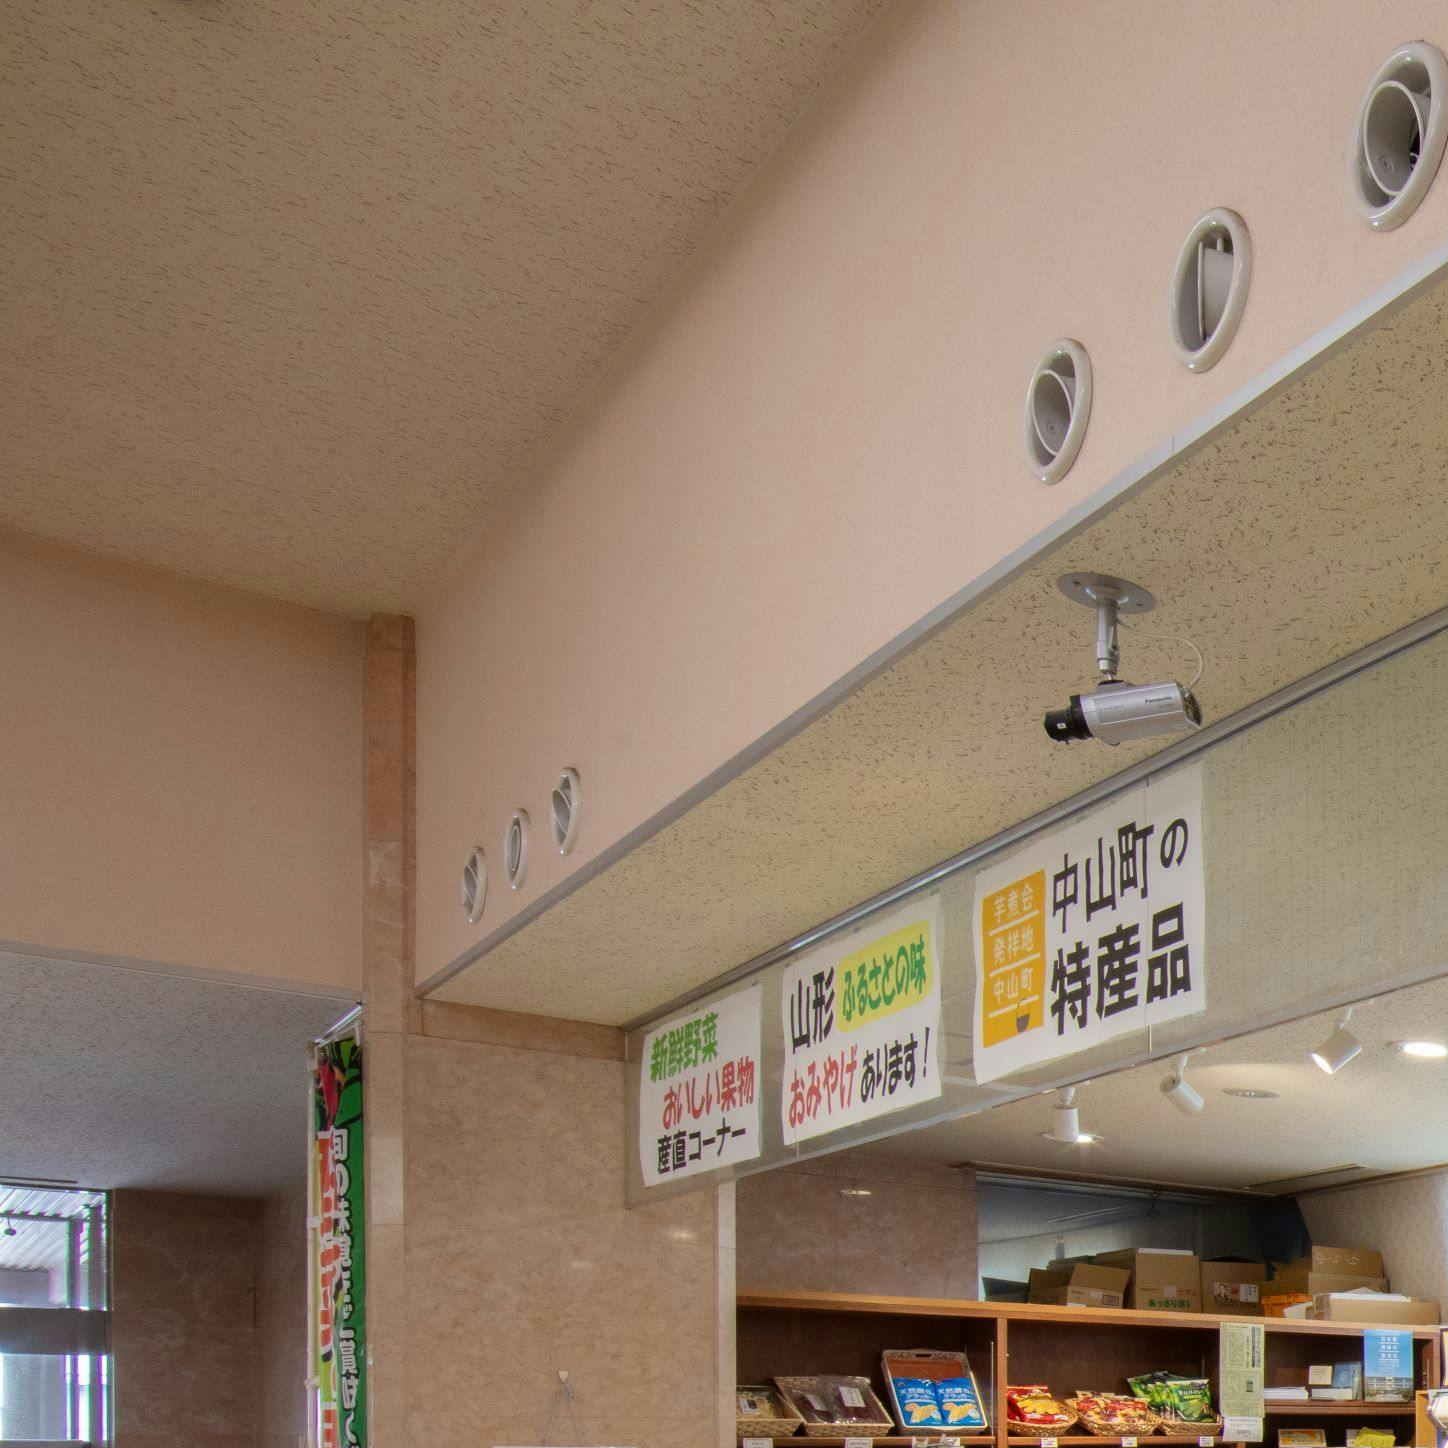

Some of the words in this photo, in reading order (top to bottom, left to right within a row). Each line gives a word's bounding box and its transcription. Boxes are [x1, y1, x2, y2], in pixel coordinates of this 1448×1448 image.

[993, 884, 1034, 921] 芋煮会
[1052, 818, 1188, 933] 中山町の
[993, 930, 1034, 964] 発祥地
[1051, 903, 1192, 1036] 特産品
[790, 967, 835, 1054] 山形
[841, 934, 926, 1022] ふるさとの味
[993, 973, 1033, 1005] 中山町
[650, 1012, 718, 1083] 新鮮野菜
[663, 1056, 754, 1130] おいしい果物
[788, 1050, 857, 1128] おみやげ
[657, 1117, 746, 1175] 産直コーナー
